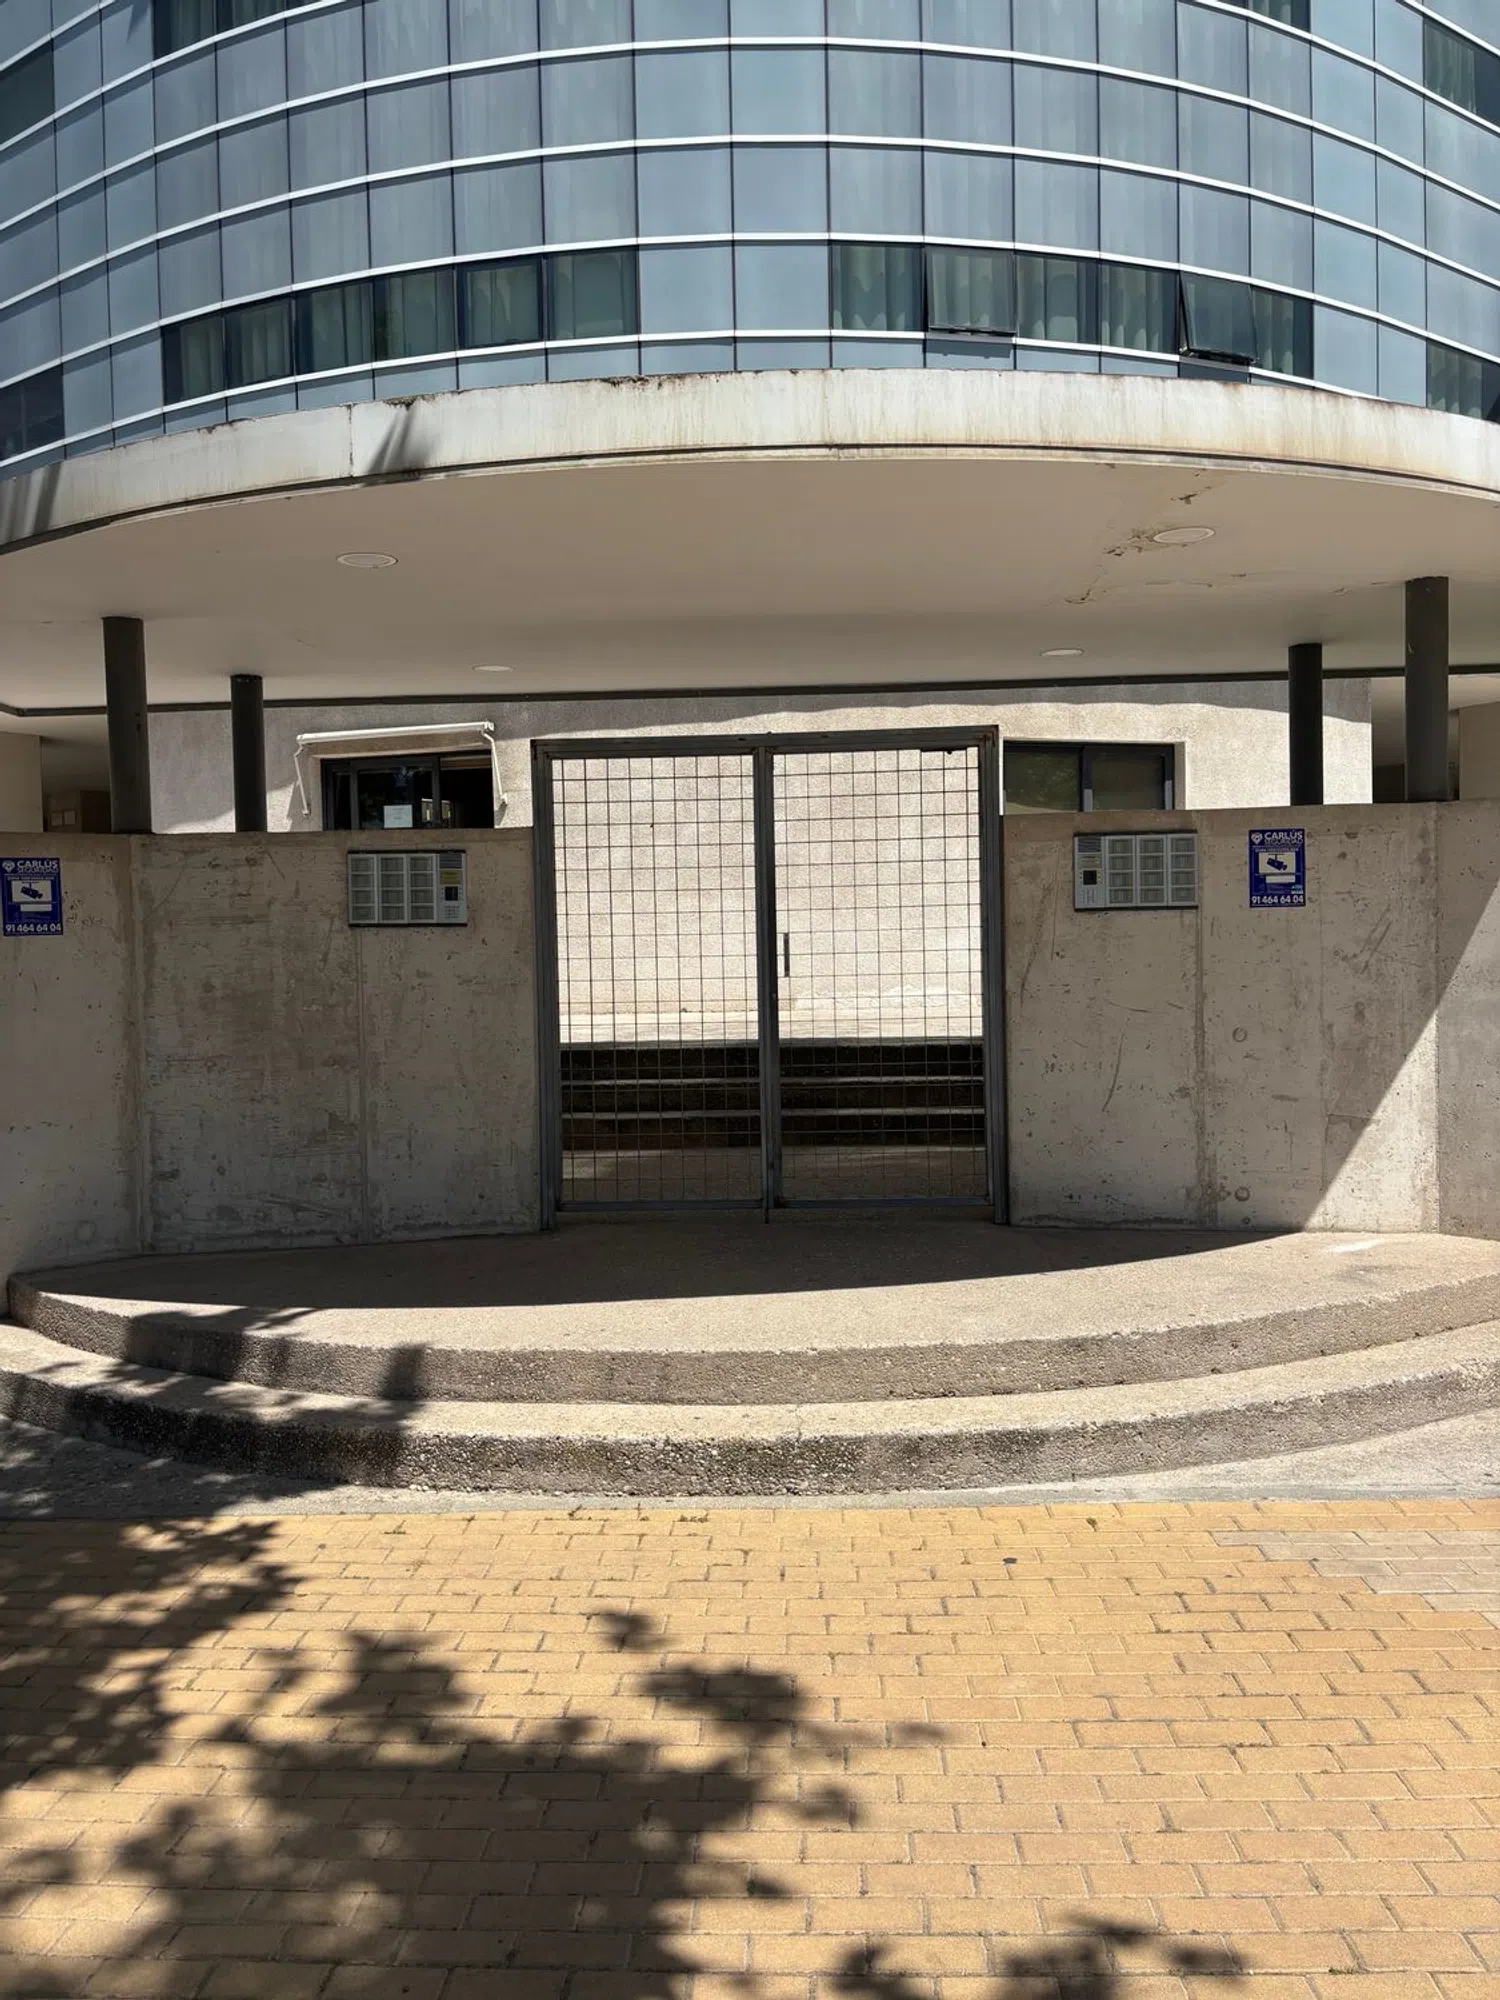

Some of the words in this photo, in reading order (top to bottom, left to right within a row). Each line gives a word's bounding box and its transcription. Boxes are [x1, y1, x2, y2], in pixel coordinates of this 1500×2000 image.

[1251, 896, 1261, 904] 91
[1262, 895, 1279, 904] 464
[1280, 895, 1291, 904] 64
[1293, 894, 1304, 903] 04
[5, 924, 16, 932] 91
[17, 924, 35, 932] 464
[36, 924, 48, 932] 64
[49, 923, 61, 931] 04
